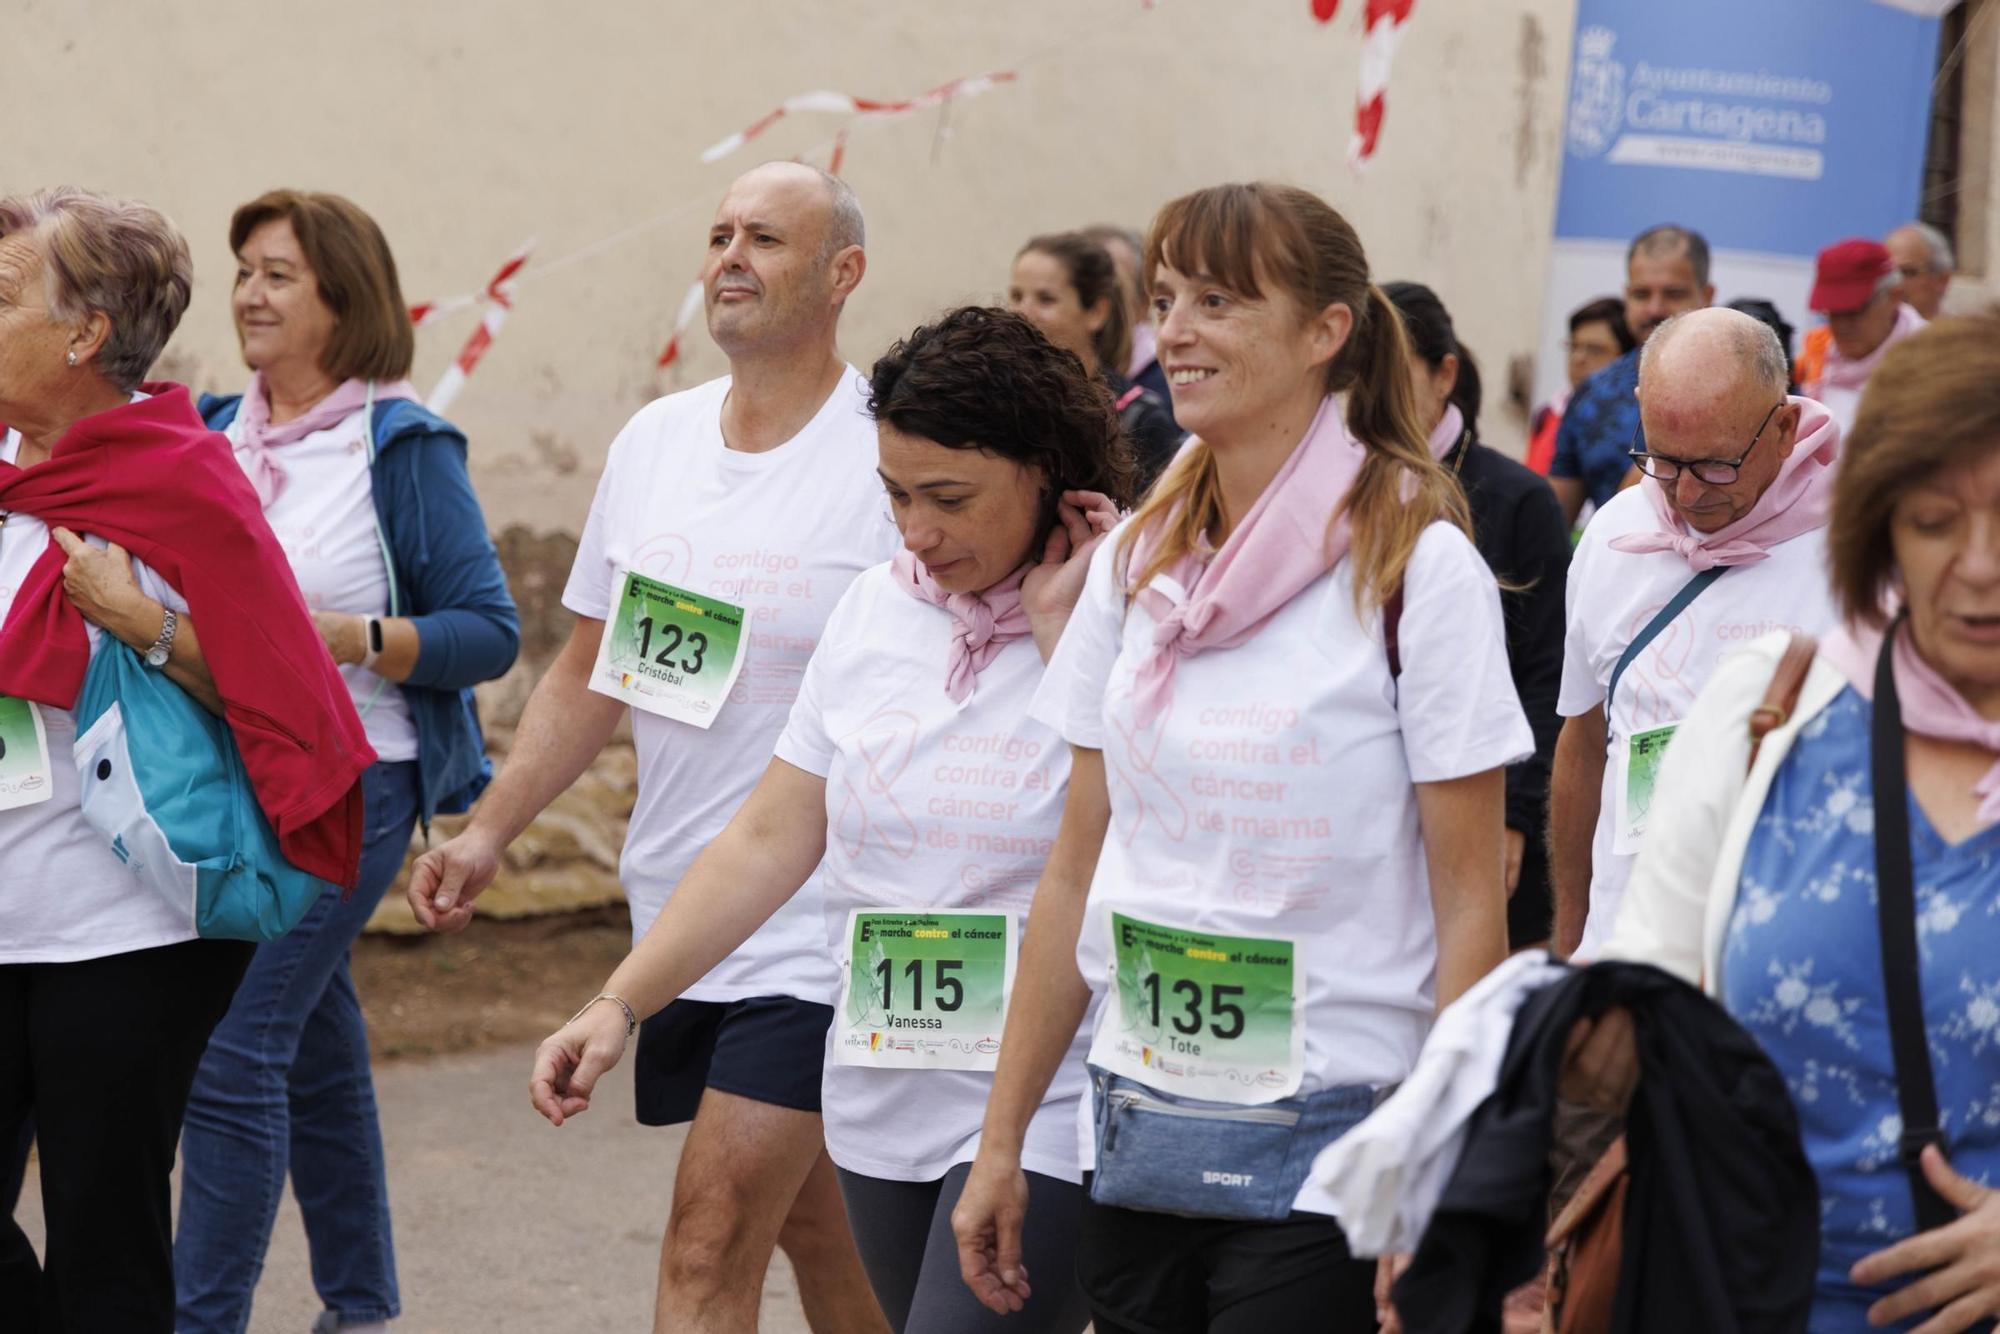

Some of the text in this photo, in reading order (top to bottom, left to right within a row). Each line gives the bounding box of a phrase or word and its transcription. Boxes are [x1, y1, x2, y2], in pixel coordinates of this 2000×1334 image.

[1632, 60, 1832, 104] Ayuntamiento
[1627, 89, 1826, 144] Cartagena
[714, 550, 799, 573] contigo
[787, 579, 812, 599] el
[646, 591, 675, 607] marcha
[676, 601, 704, 616] contra
[704, 609, 712, 618] el
[638, 616, 708, 675] 123
[637, 662, 684, 687] Cristóbal
[1198, 703, 1300, 734] contigo
[943, 731, 1041, 761] contigo
[1189, 736, 1321, 766] contra el
[934, 763, 1051, 791] contra el
[1190, 770, 1288, 801] cáncer
[928, 791, 1020, 821] cáncer
[1195, 805, 1331, 840] de mama
[925, 824, 1055, 856] de mama
[880, 928, 912, 938] marcha
[914, 928, 949, 939] contra
[951, 928, 961, 939] el
[964, 926, 1002, 940] cáncer
[1145, 940, 1185, 955] marcha
[1186, 947, 1228, 962] contra
[1230, 952, 1242, 964] el
[1246, 952, 1289, 967] cáncer
[877, 958, 964, 1012] 115
[1143, 971, 1246, 1040] 135
[886, 1014, 943, 1030] Vanessa
[1169, 1036, 1200, 1057] Tote
[1202, 1171, 1254, 1187] SPORT
